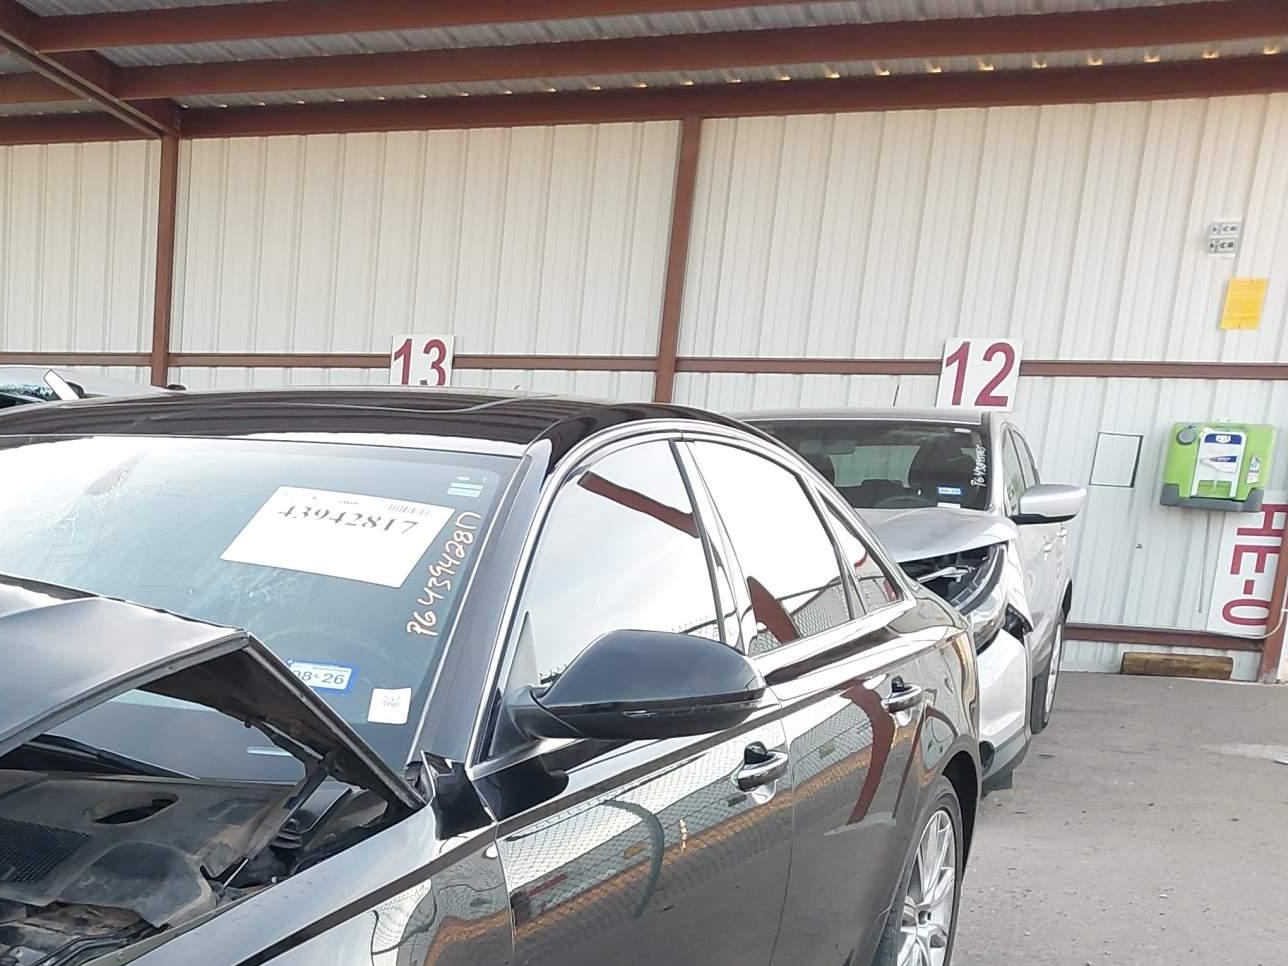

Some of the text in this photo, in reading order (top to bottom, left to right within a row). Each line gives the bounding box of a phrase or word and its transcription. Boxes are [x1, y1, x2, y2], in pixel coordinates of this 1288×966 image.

[394, 338, 447, 386] 13
[945, 341, 1015, 406] 12
[277, 505, 419, 534] 43942817
